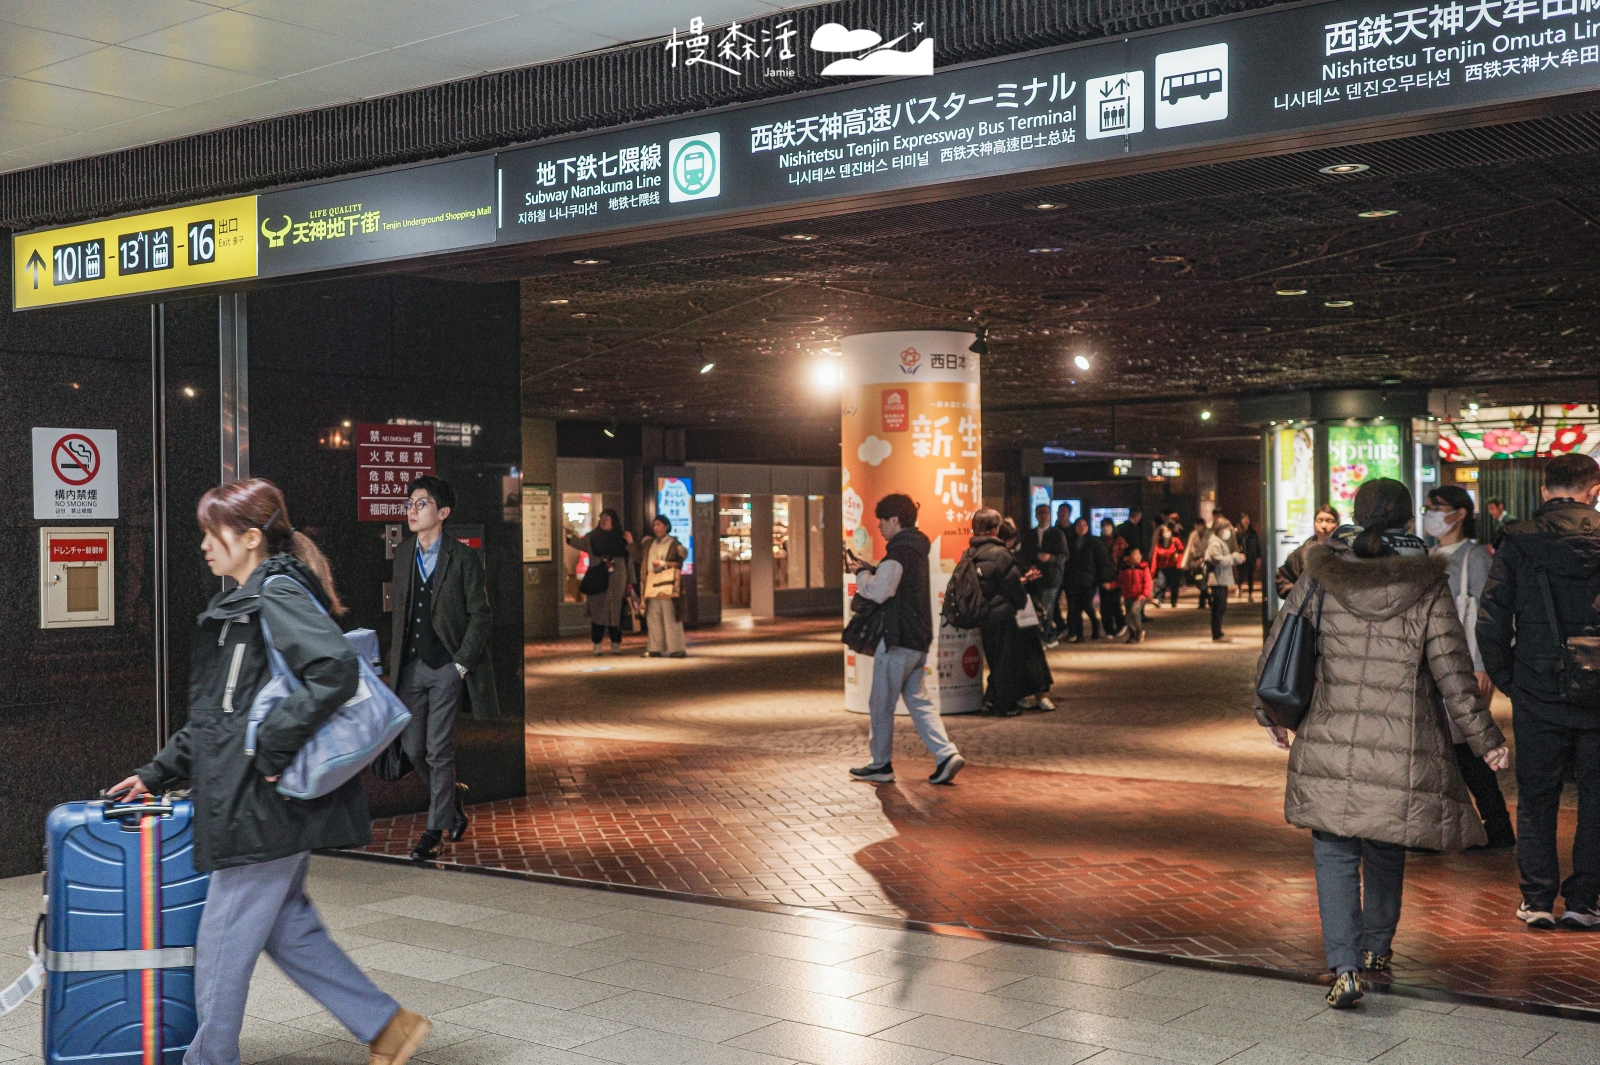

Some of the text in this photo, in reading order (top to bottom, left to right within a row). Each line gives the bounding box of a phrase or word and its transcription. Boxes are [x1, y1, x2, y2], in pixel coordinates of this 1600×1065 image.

[1325, 0, 1600, 56] 西鉄天神大牟田
[1322, 53, 1417, 80] Nishitetsu
[1422, 40, 1485, 64] Tenjin
[1492, 27, 1566, 52] Omuta
[1465, 45, 1599, 83] 西铁天神大牟田
[1274, 68, 1451, 111] 니시테쓰 덴진오무타선
[751, 72, 1077, 153] 西鉄天神高速バスターミナル
[779, 105, 1077, 169] Nishitetsu Tenjin Expressway Bus Terminal
[940, 127, 1076, 163] 西铁天神高速巴士总站
[536, 143, 662, 187] 地下鉄七隈線
[788, 151, 930, 186] 니시테쓰 덴진버스 터미널
[525, 174, 661, 206] Subway Nanakuma Line
[608, 191, 660, 211] 地铁七隈线
[219, 218, 238, 235] 出口
[292, 210, 381, 244] 天神地下街
[309, 203, 363, 219] LIFE QUALITY
[382, 205, 492, 231] Tenjin Underground Shopping Mall
[518, 201, 598, 225] 지하철 나나쿠마선
[53, 246, 77, 281] 10
[189, 223, 214, 261] 16
[218, 238, 231, 247] Exit
[370, 430, 380, 442] 禁
[413, 432, 423, 444] 煙
[912, 414, 982, 458] 新生
[1328, 438, 1401, 468] Spring
[370, 450, 423, 463] 火気厳禁
[55, 489, 97, 500] 構内禁煙
